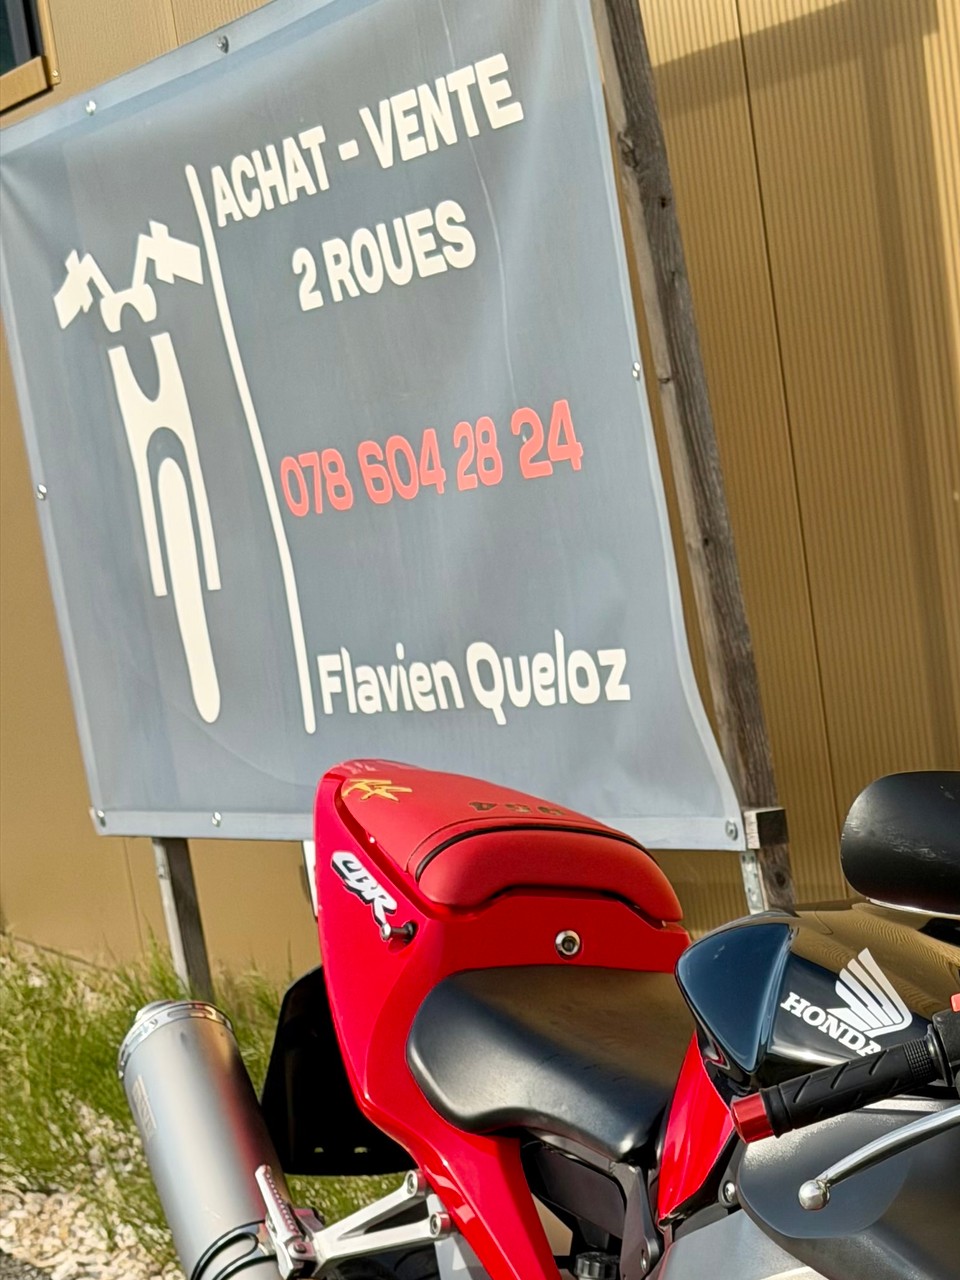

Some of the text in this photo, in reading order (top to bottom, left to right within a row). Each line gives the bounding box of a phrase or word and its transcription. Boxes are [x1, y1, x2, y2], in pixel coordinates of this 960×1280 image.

[211, 126, 333, 226] ACHAT
[359, 53, 524, 168] VENTE
[292, 199, 477, 311] 2 ROUES
[279, 399, 584, 517] 078 604 28 24
[317, 630, 631, 725] Flavien Queloz
[331, 850, 398, 932] CBR
[780, 992, 882, 1057] HONDA
